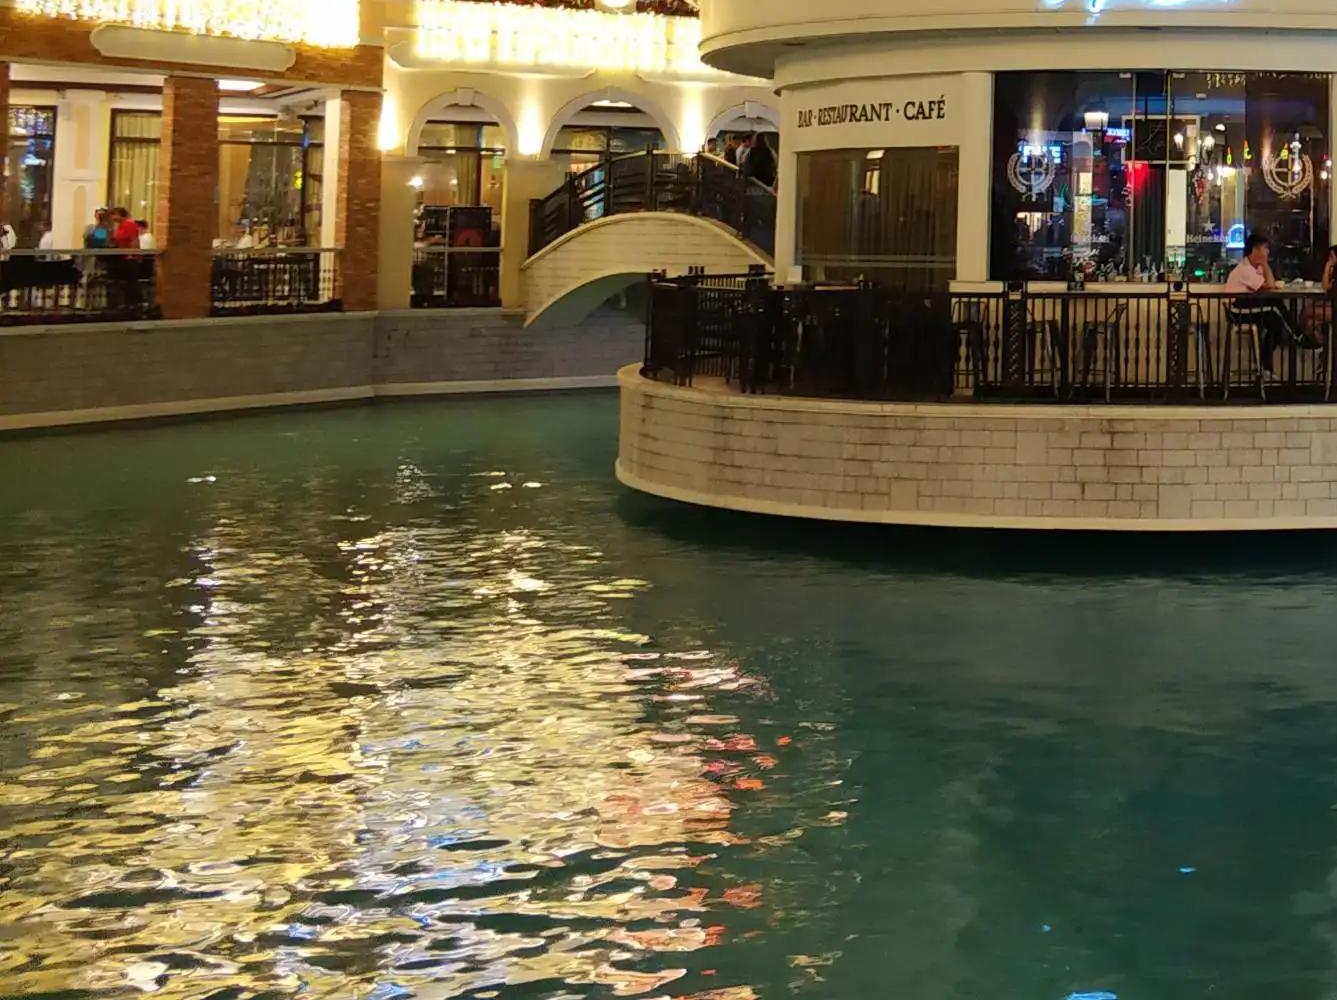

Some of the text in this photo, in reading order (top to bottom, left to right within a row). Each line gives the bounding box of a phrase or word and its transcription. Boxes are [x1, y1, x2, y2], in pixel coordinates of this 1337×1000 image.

[797, 94, 945, 128] BAR RESTAURANT CAFÉ
